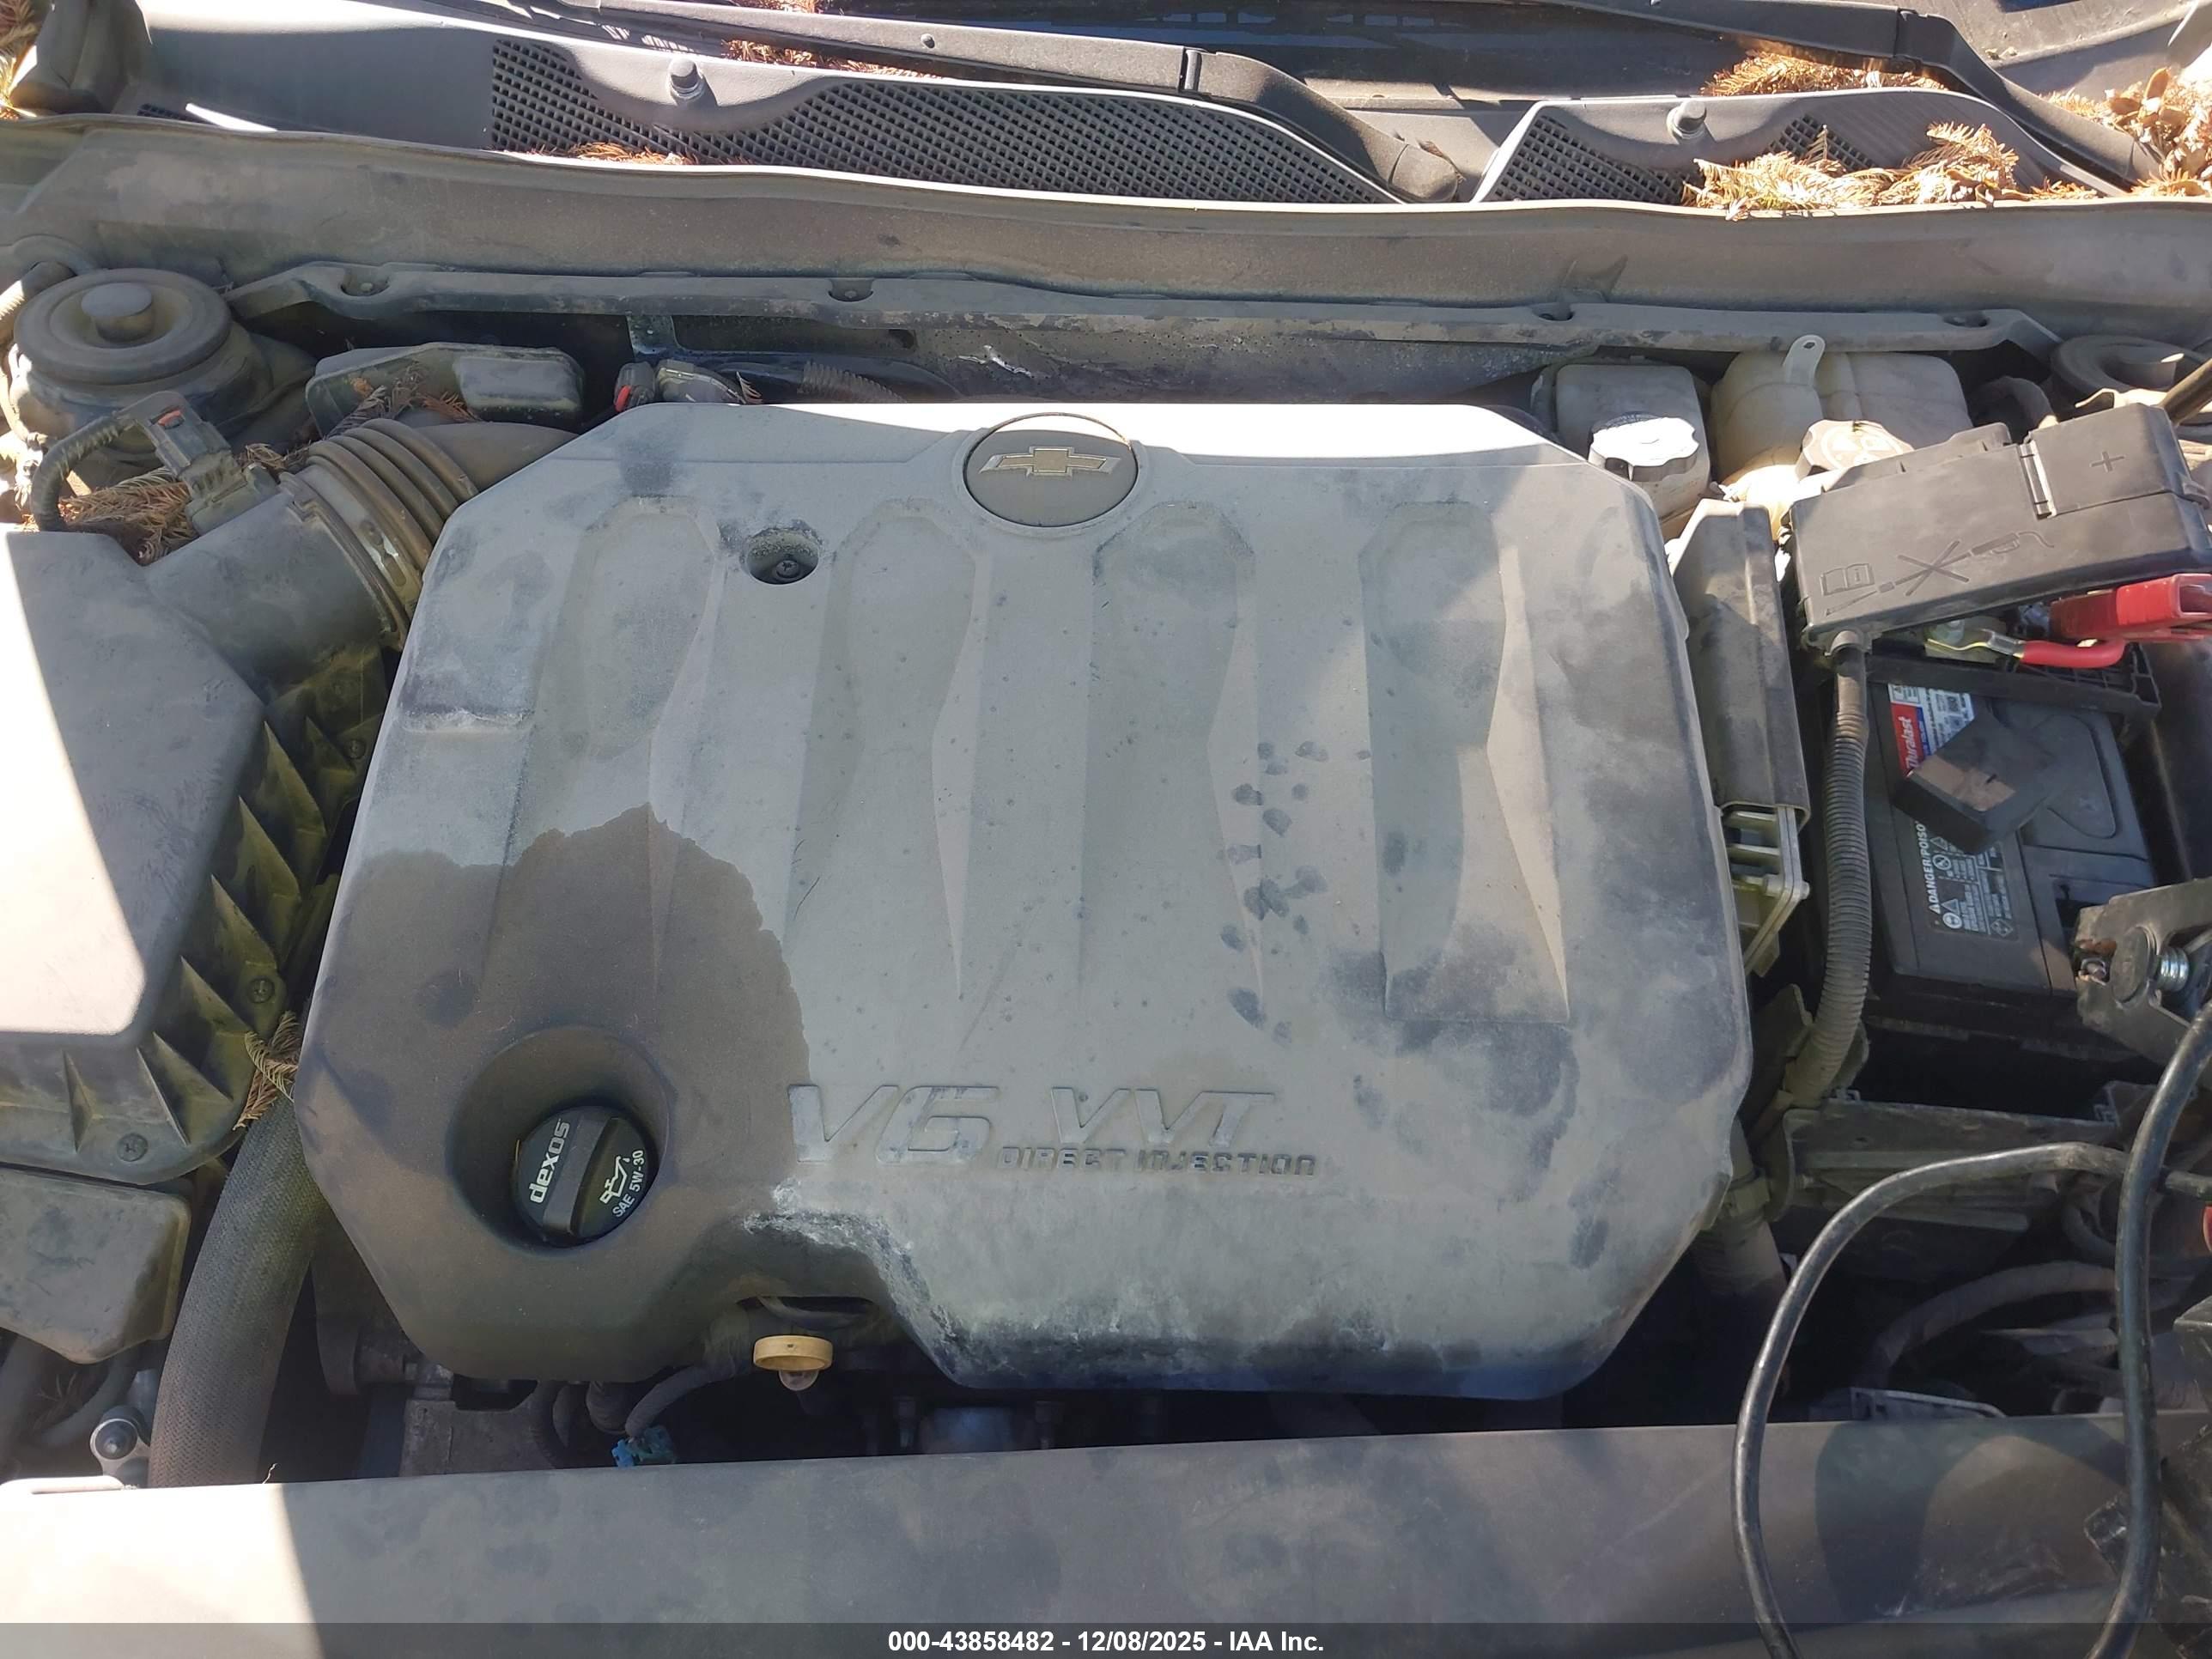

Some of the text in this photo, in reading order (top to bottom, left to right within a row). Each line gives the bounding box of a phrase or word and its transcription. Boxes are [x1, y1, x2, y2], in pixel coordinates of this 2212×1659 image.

[1898, 716, 1919, 769] Duralast
[1915, 821, 1940, 906] DANGER/POISO
[528, 1120, 571, 1204] dexos
[786, 1084, 1275, 1165] V6 VVT
[997, 1146, 1316, 1177] DIRECT INJECTION
[611, 1149, 646, 1218] SAE 5W-30
